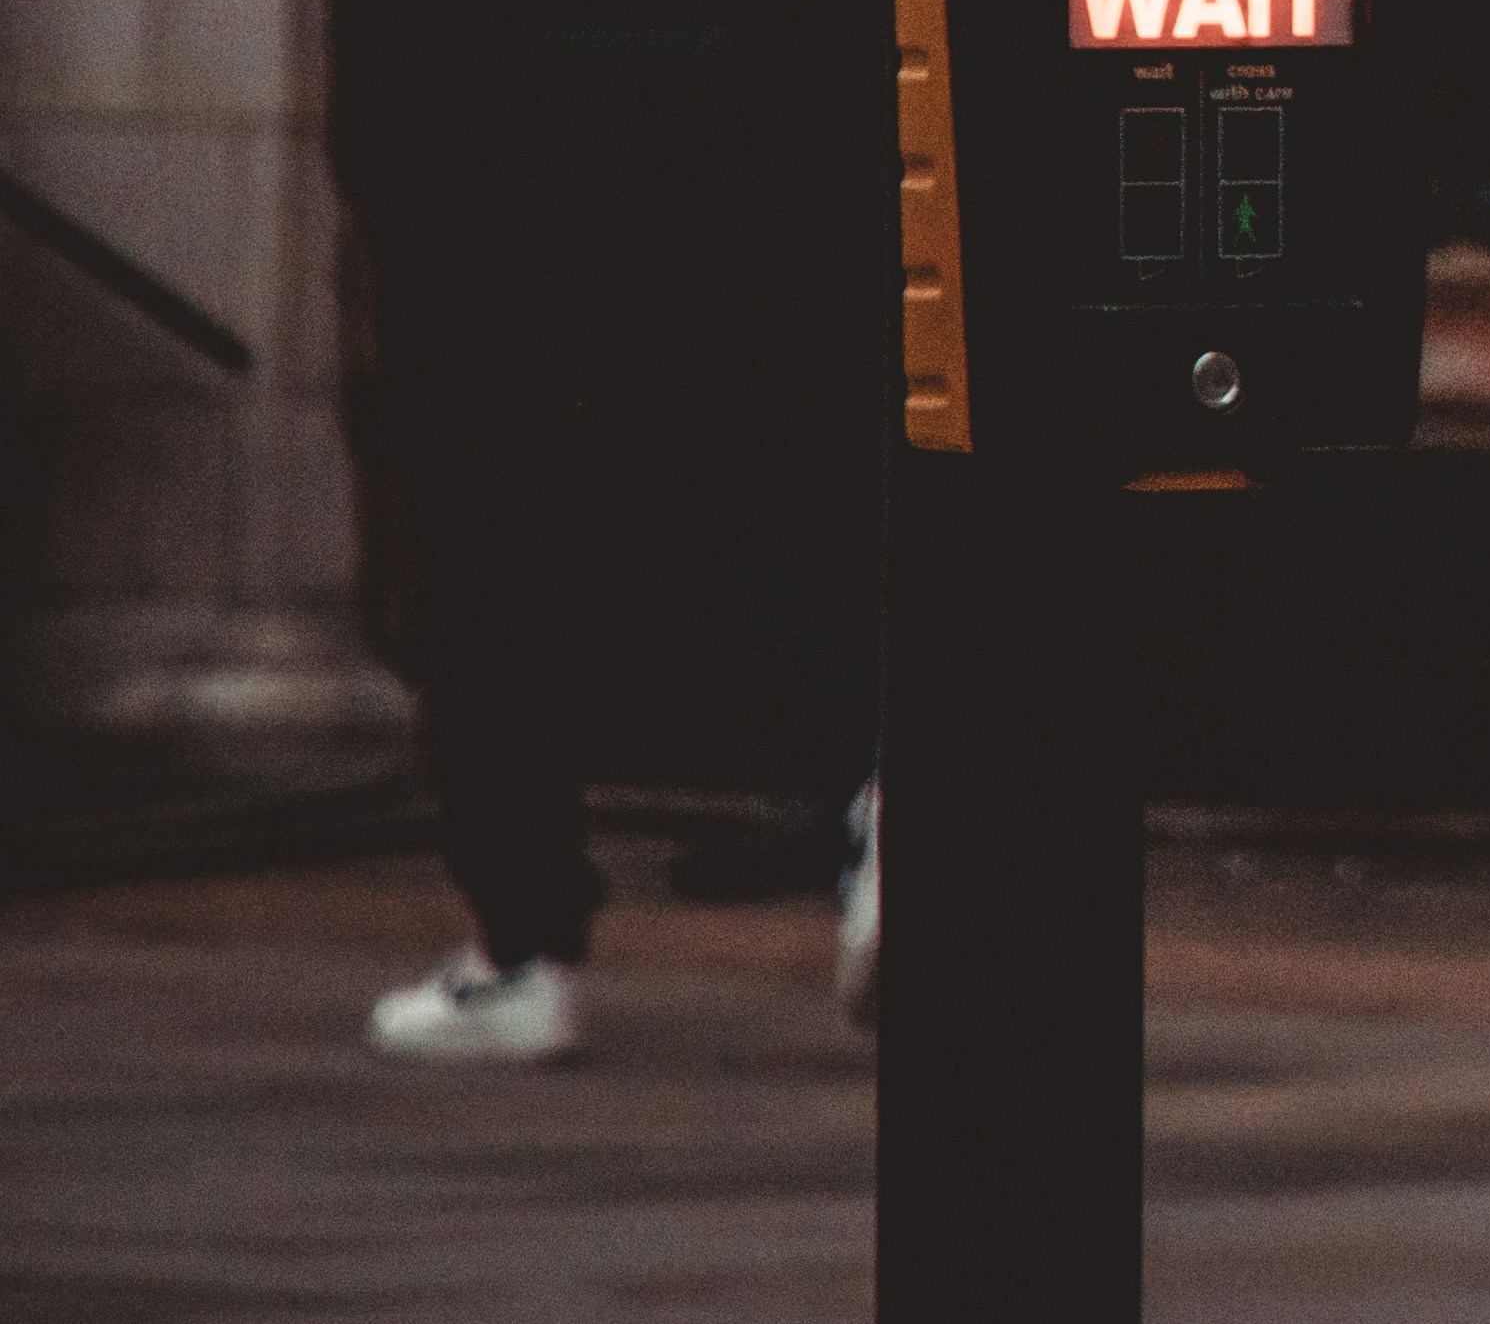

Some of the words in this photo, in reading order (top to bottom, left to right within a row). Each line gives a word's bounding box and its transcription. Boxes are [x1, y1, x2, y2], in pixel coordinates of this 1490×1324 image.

[1132, 62, 1175, 80] wait
[1209, 84, 1250, 101] with
[1255, 86, 1294, 101] care
